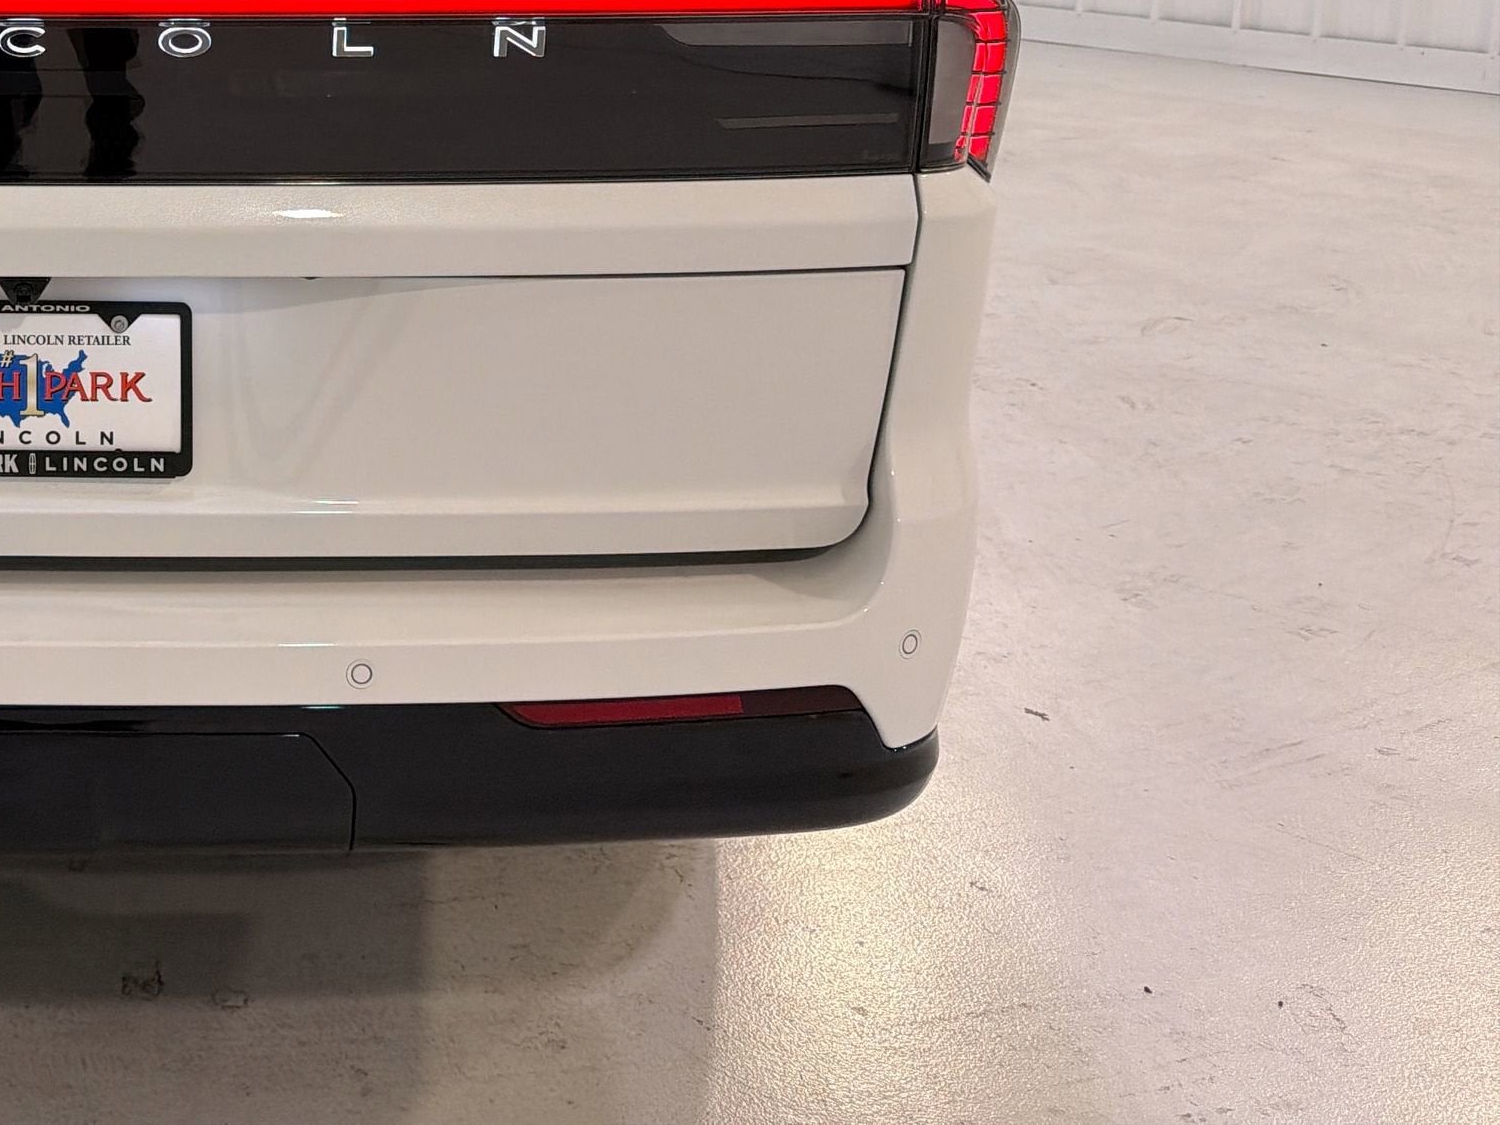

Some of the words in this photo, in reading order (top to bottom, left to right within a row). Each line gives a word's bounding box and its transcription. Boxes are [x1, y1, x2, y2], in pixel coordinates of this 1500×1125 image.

[1, 304, 91, 313] ANTONIO
[3, 334, 64, 346] LINCOLN
[67, 335, 131, 346] RETAILER
[44, 371, 152, 402] PARK
[45, 457, 165, 473] LINCOLN
